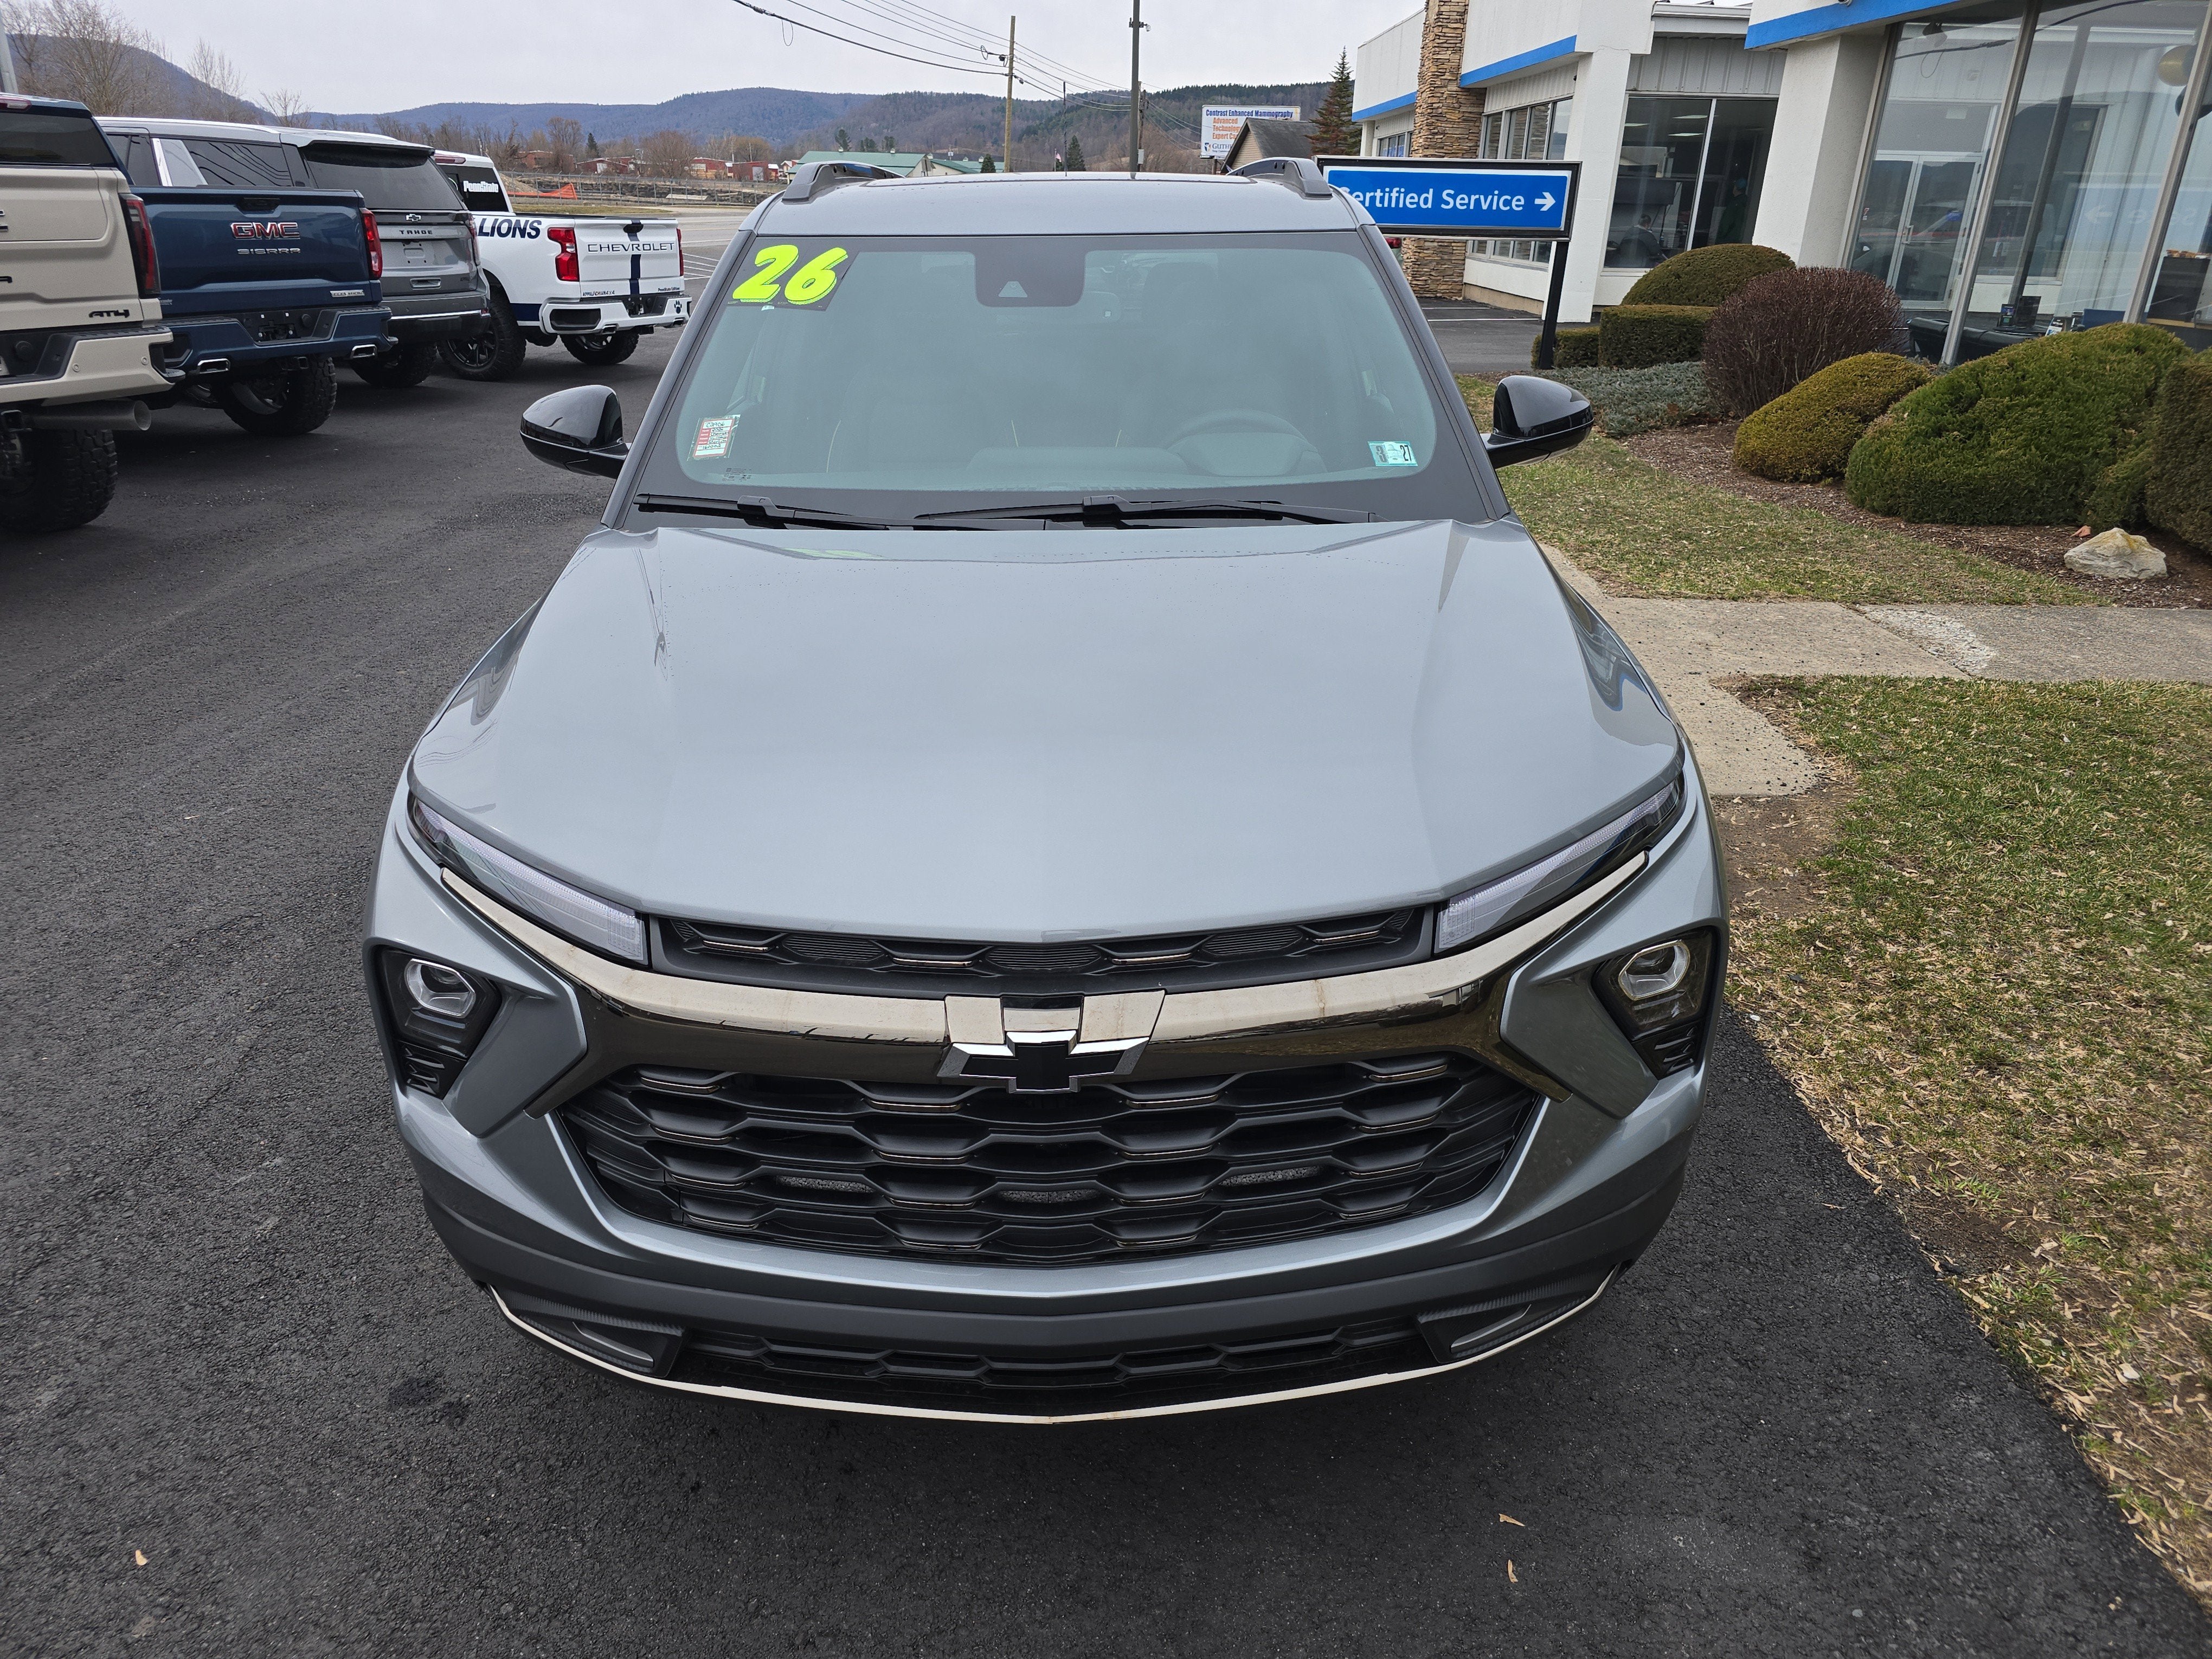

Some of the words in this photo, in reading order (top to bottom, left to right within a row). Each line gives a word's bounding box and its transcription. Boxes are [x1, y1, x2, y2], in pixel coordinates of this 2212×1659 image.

[1255, 110, 1294, 118] Mammography
[1441, 189, 1525, 211] Service
[230, 222, 301, 240] GMC
[478, 218, 542, 239] LIONS
[588, 242, 674, 252] CHEVROLET
[732, 245, 848, 305] 26
[88, 309, 130, 319] AT4
[1375, 445, 1387, 463] 3
[1400, 445, 1412, 463] 27
